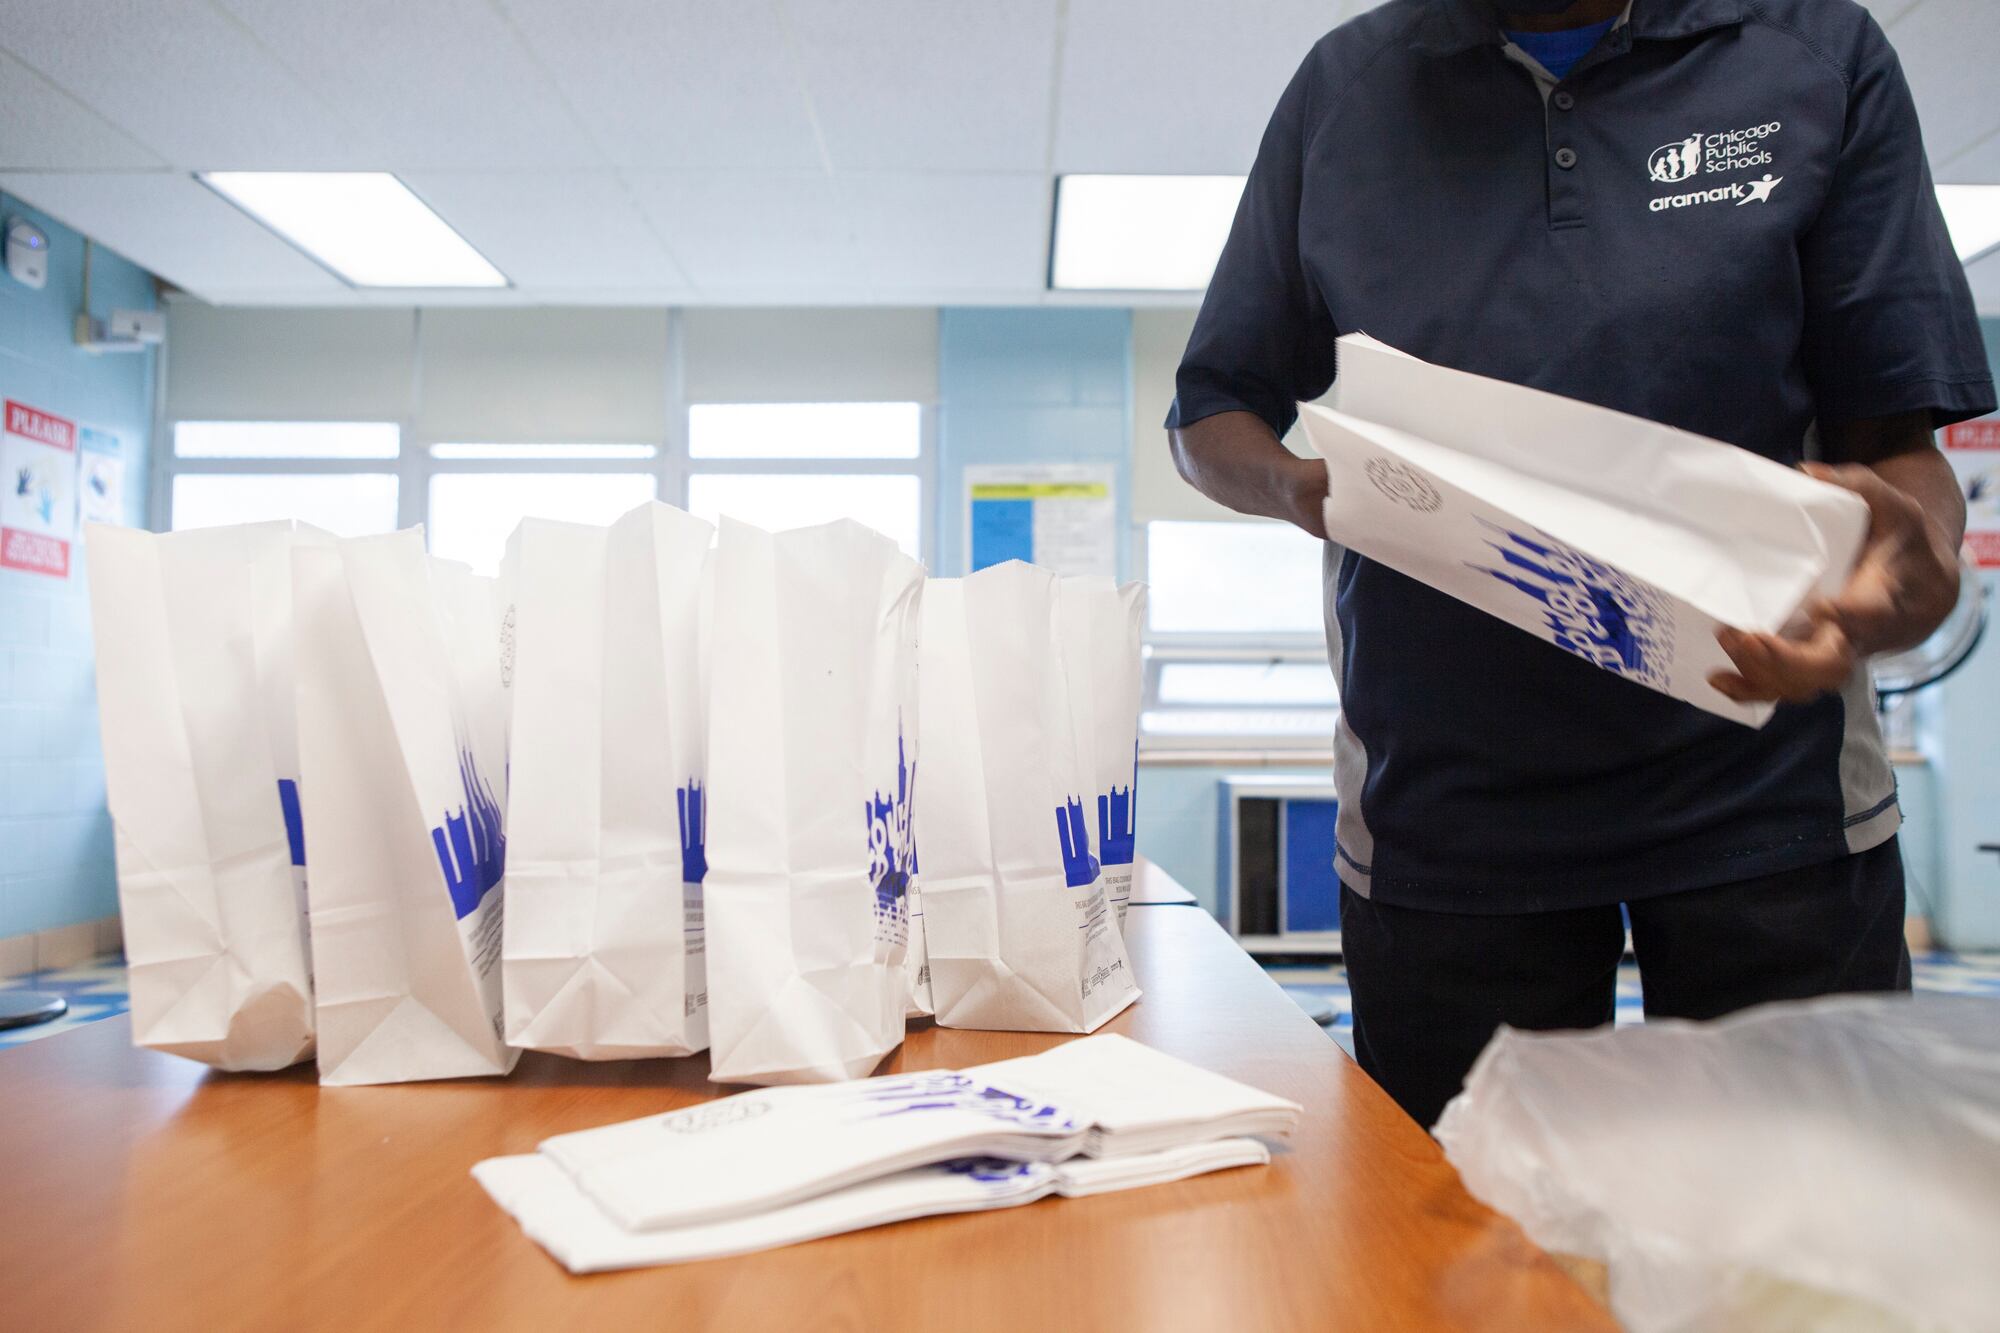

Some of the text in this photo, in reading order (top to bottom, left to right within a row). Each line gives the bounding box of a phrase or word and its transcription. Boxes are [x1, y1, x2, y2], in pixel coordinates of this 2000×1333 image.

[1705, 121, 1781, 148] Chicago
[1705, 150, 1773, 173] Schools
[1706, 140, 1758, 161] Public
[1649, 183, 1745, 212] aramark
